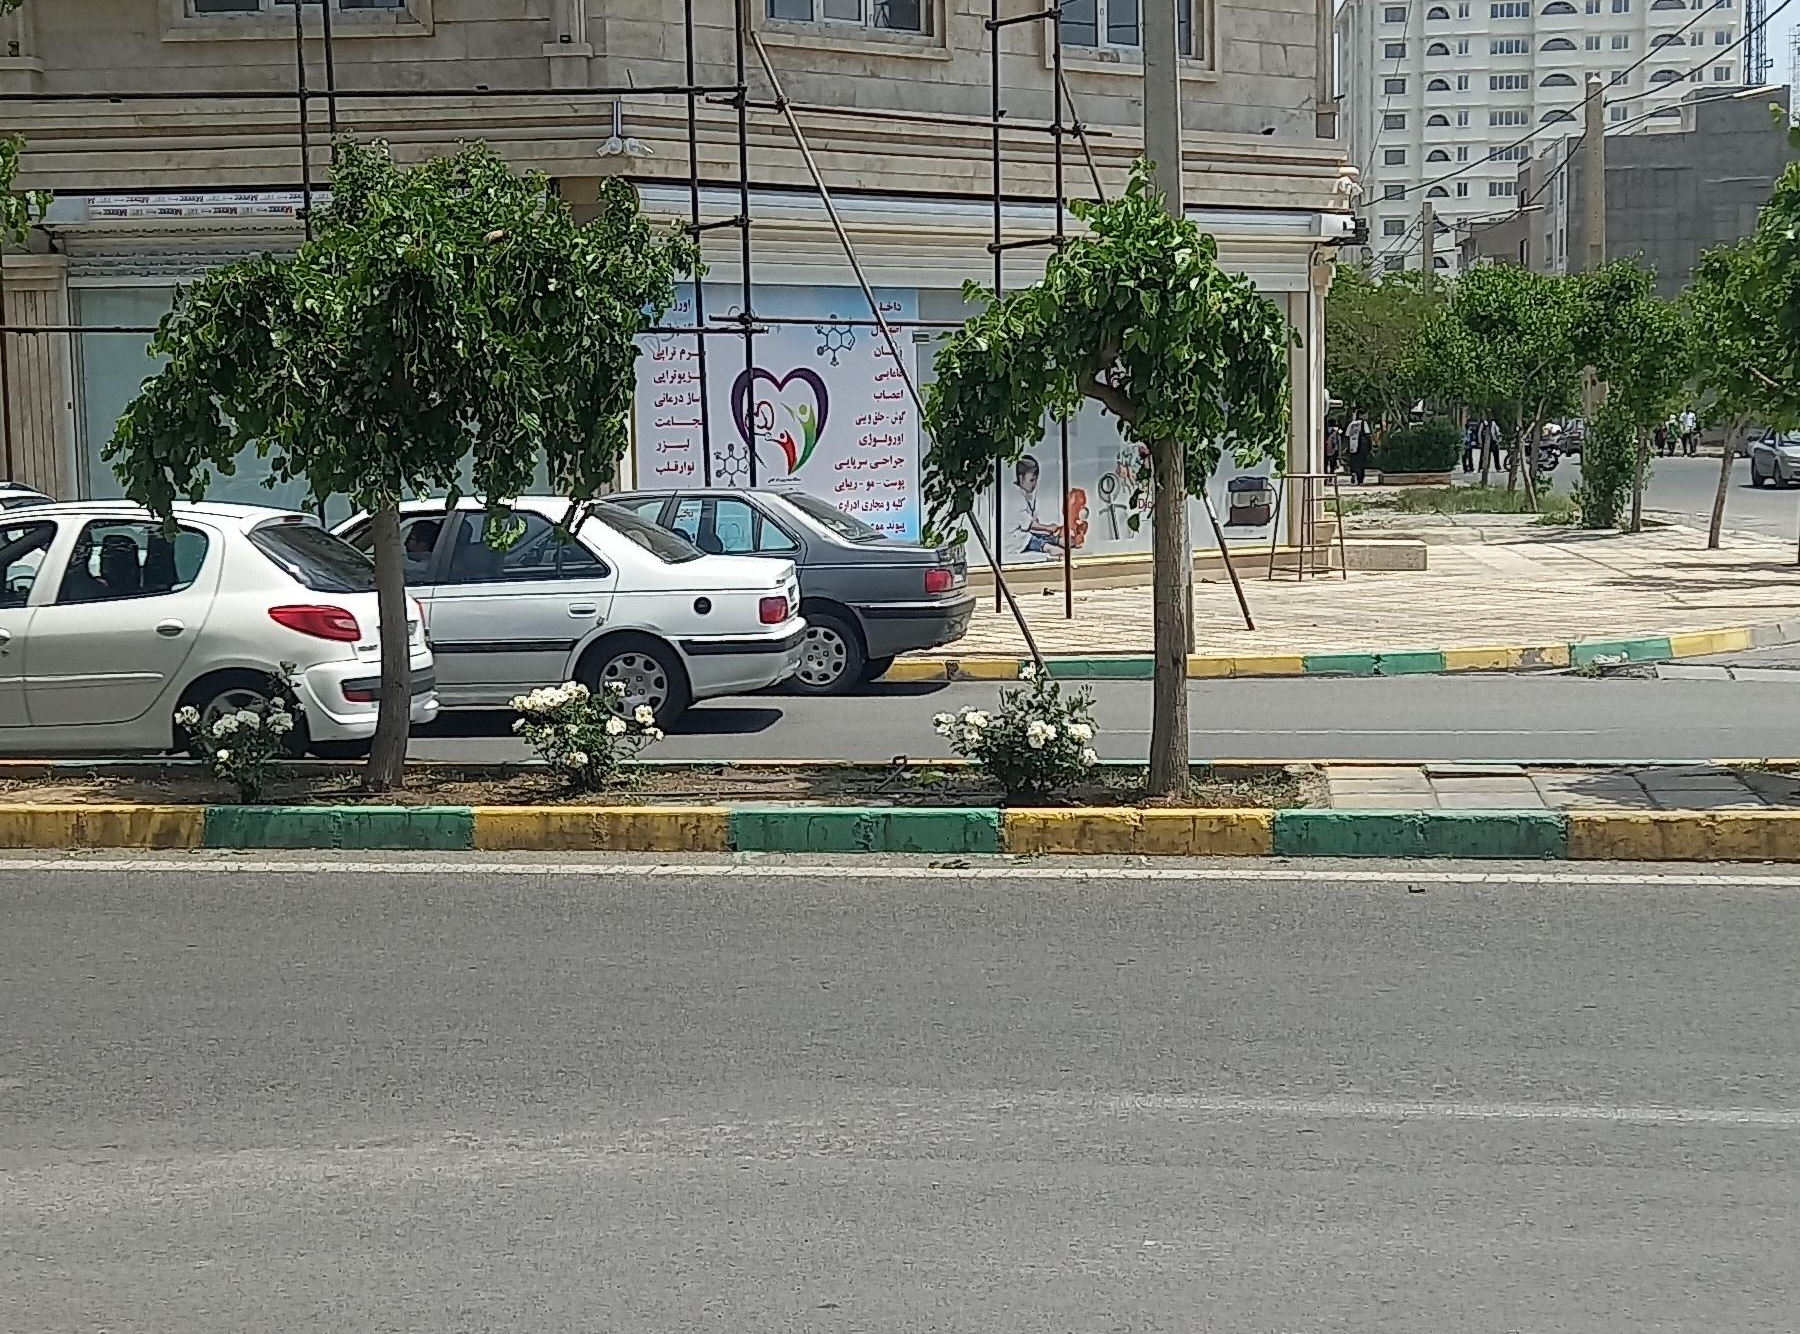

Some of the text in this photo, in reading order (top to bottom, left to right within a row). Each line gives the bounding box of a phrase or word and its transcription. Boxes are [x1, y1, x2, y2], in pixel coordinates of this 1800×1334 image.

[876, 301, 902, 312] داخل
[653, 346, 676, 361] تراپی
[654, 393, 684, 407] درمانی
[654, 416, 704, 428] جامت
[656, 438, 690, 453] لیزر
[859, 433, 904, 447] اورولوژی
[834, 455, 905, 470] جراحی سرپایی
[866, 480, 875, 491] مو
[883, 479, 905, 490] پوست
